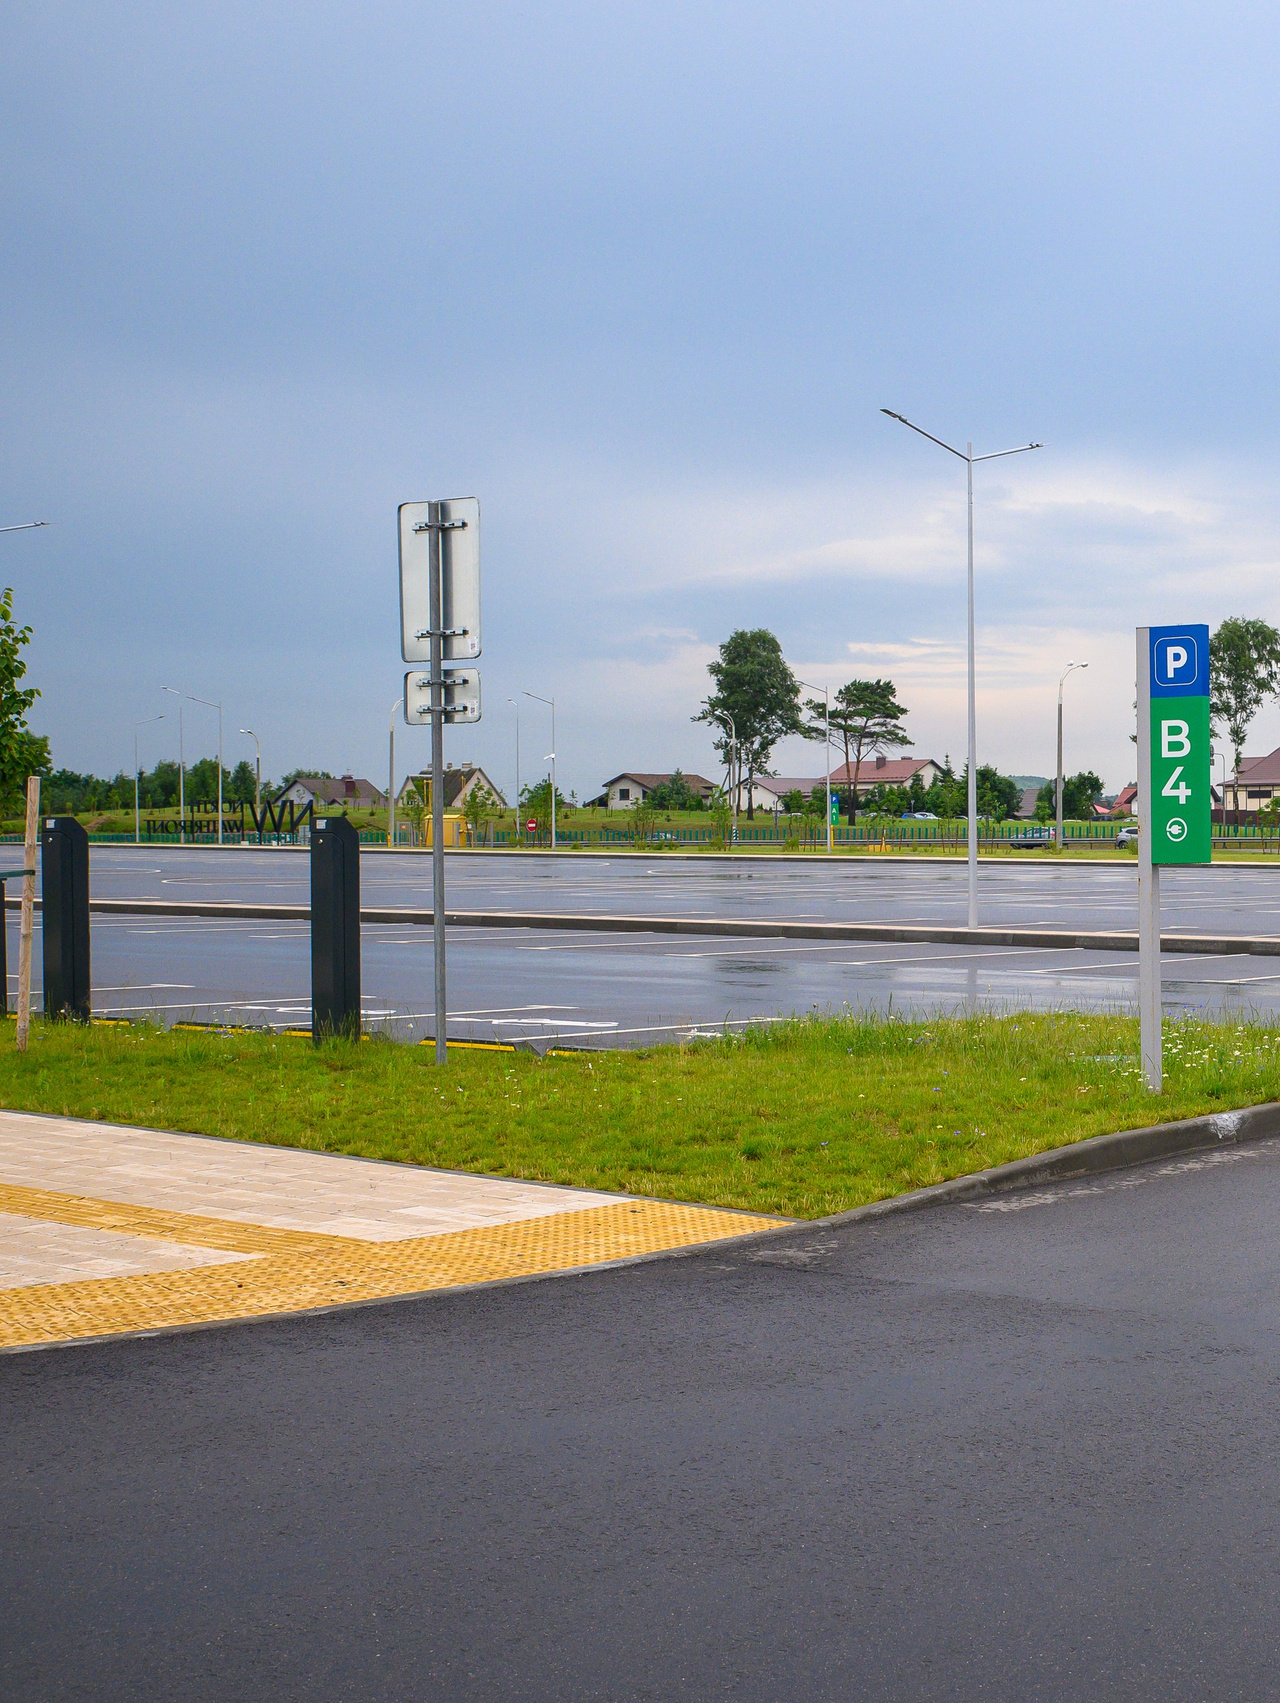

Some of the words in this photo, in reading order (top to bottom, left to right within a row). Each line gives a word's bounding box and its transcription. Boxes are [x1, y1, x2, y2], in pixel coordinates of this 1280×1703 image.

[1166, 646, 1188, 678] P
[1161, 719, 1191, 758] B
[1161, 766, 1192, 805] 4
